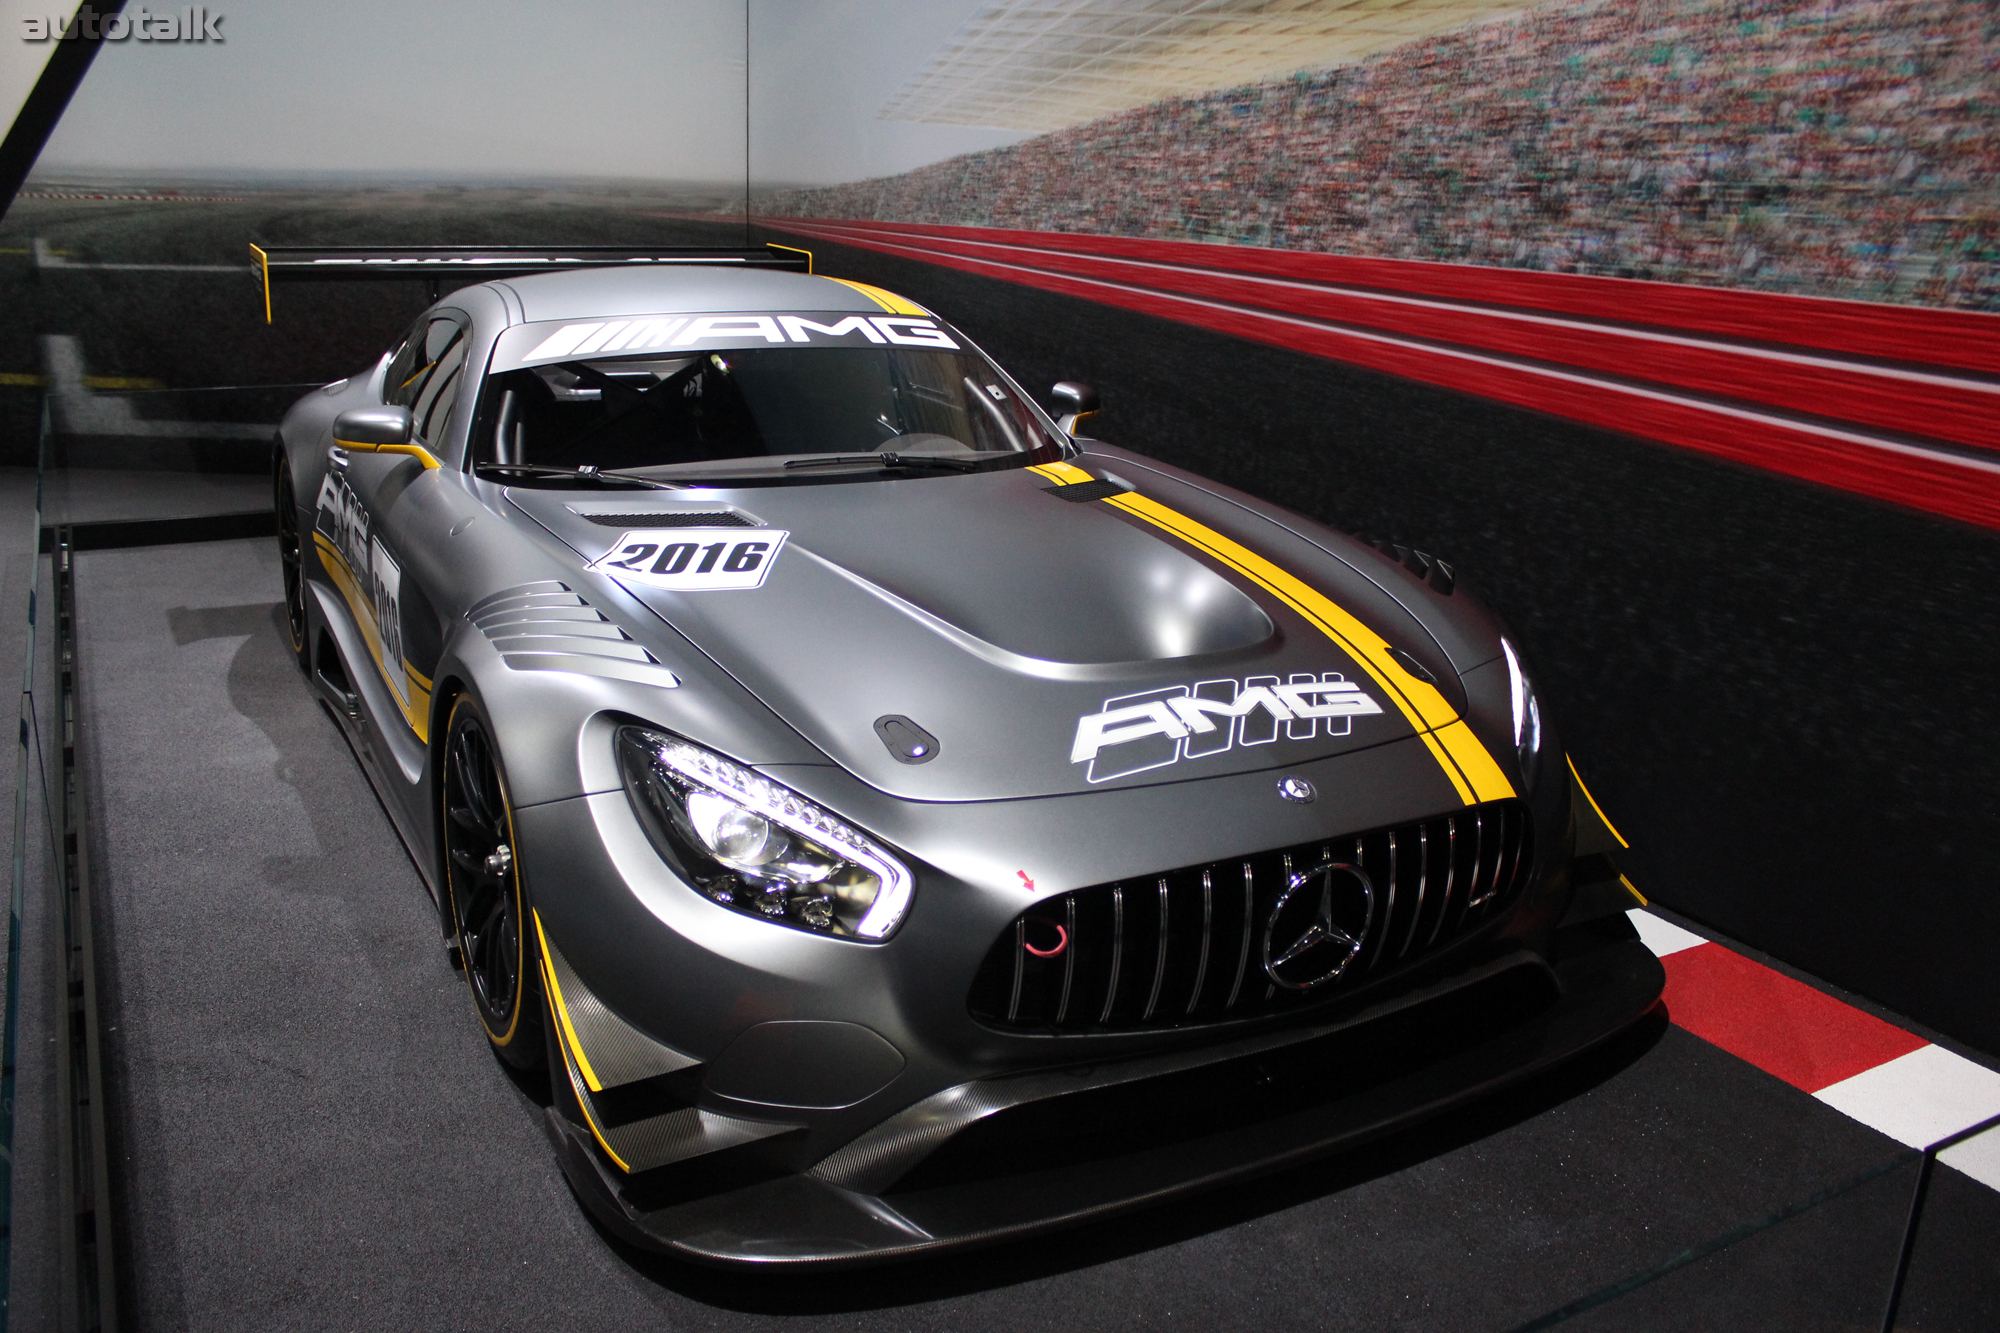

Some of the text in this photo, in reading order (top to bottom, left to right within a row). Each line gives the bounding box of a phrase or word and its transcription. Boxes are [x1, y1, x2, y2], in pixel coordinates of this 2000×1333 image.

[669, 315, 961, 350] AMG
[606, 542, 770, 574] 2016
[1070, 681, 1385, 765] AMG
